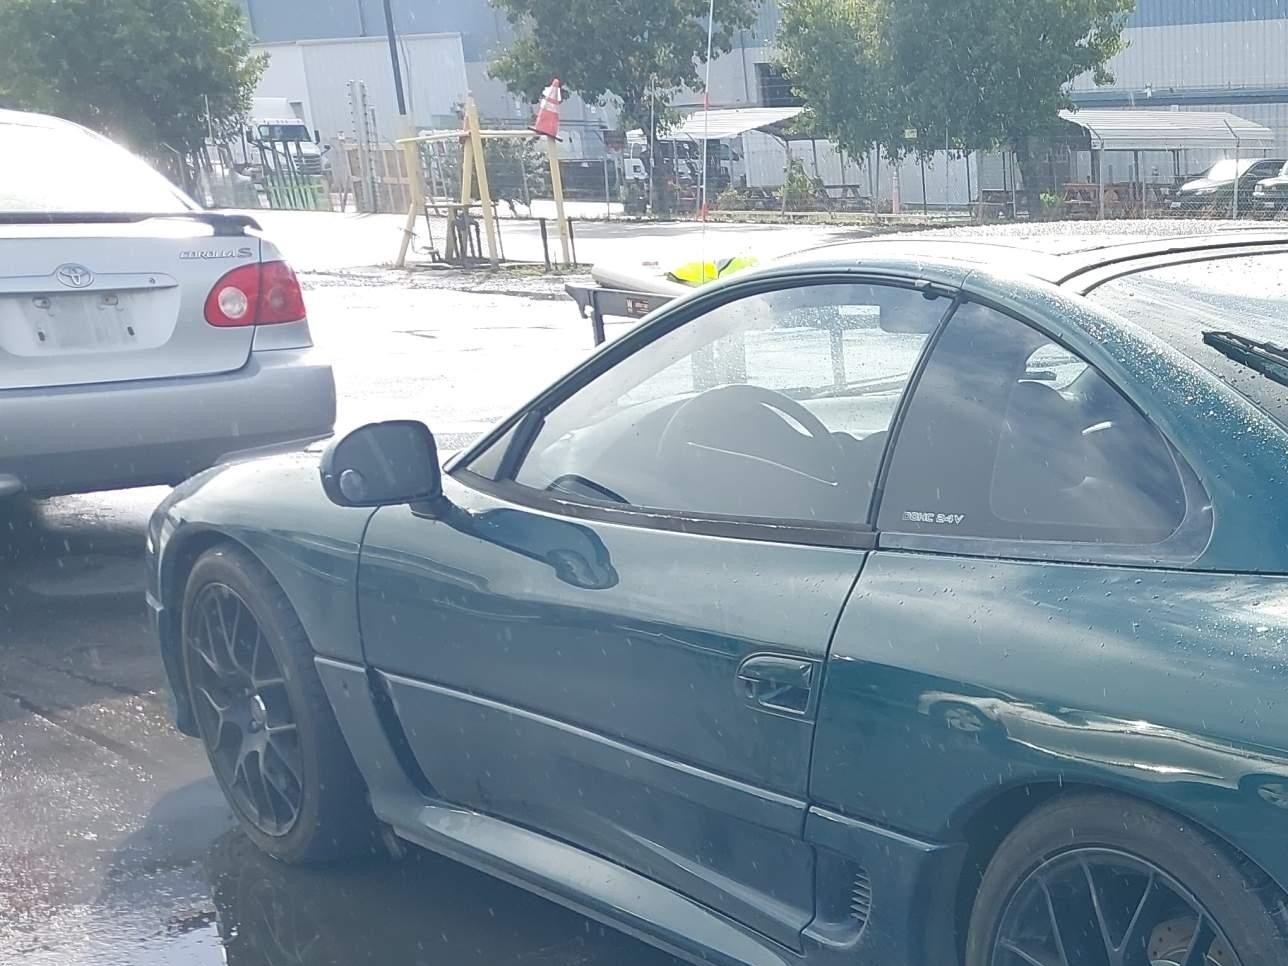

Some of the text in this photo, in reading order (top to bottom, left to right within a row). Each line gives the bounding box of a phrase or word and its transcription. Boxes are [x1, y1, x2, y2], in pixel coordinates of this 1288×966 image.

[237, 247, 253, 259] S
[902, 511, 965, 526] DOHC 24V
